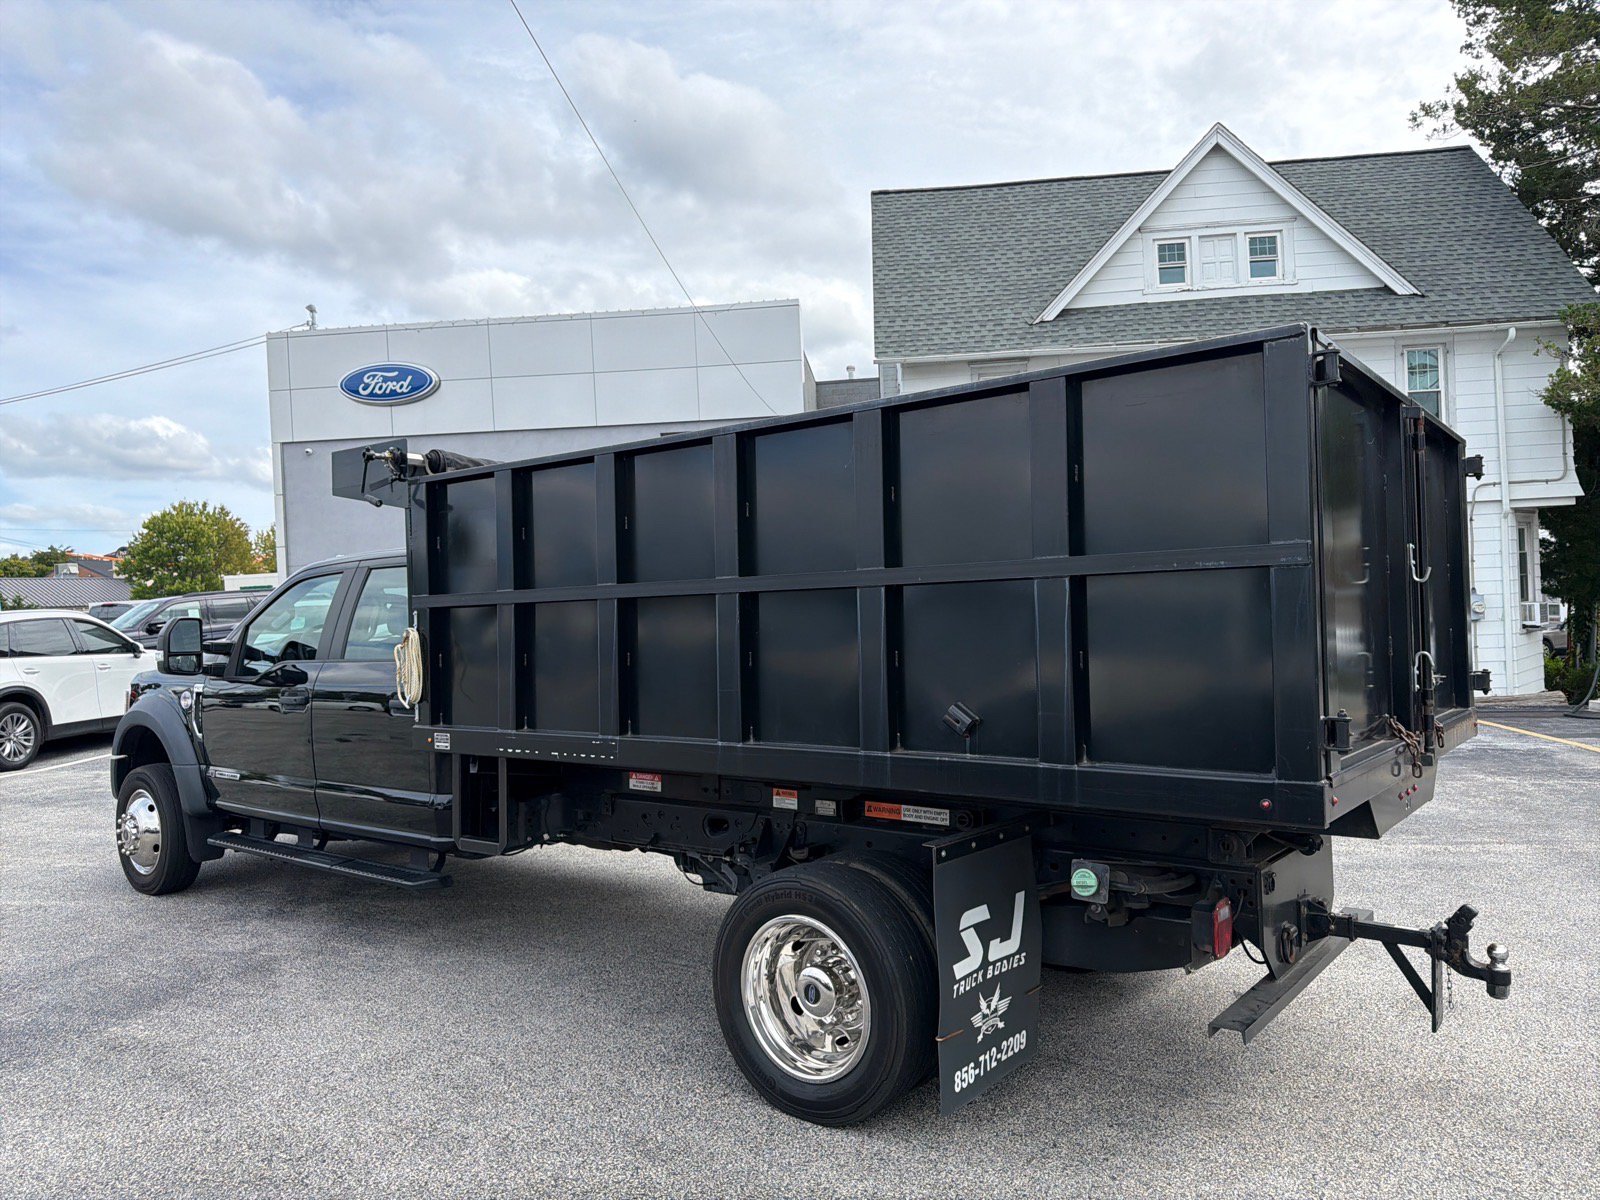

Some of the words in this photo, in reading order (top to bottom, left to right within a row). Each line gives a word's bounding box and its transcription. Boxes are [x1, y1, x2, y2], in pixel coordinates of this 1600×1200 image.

[359, 371, 413, 396] Ford
[953, 969, 984, 999] TRUCK
[986, 952, 1027, 979] BODIES
[954, 1029, 1027, 1093] 856-712-2209
